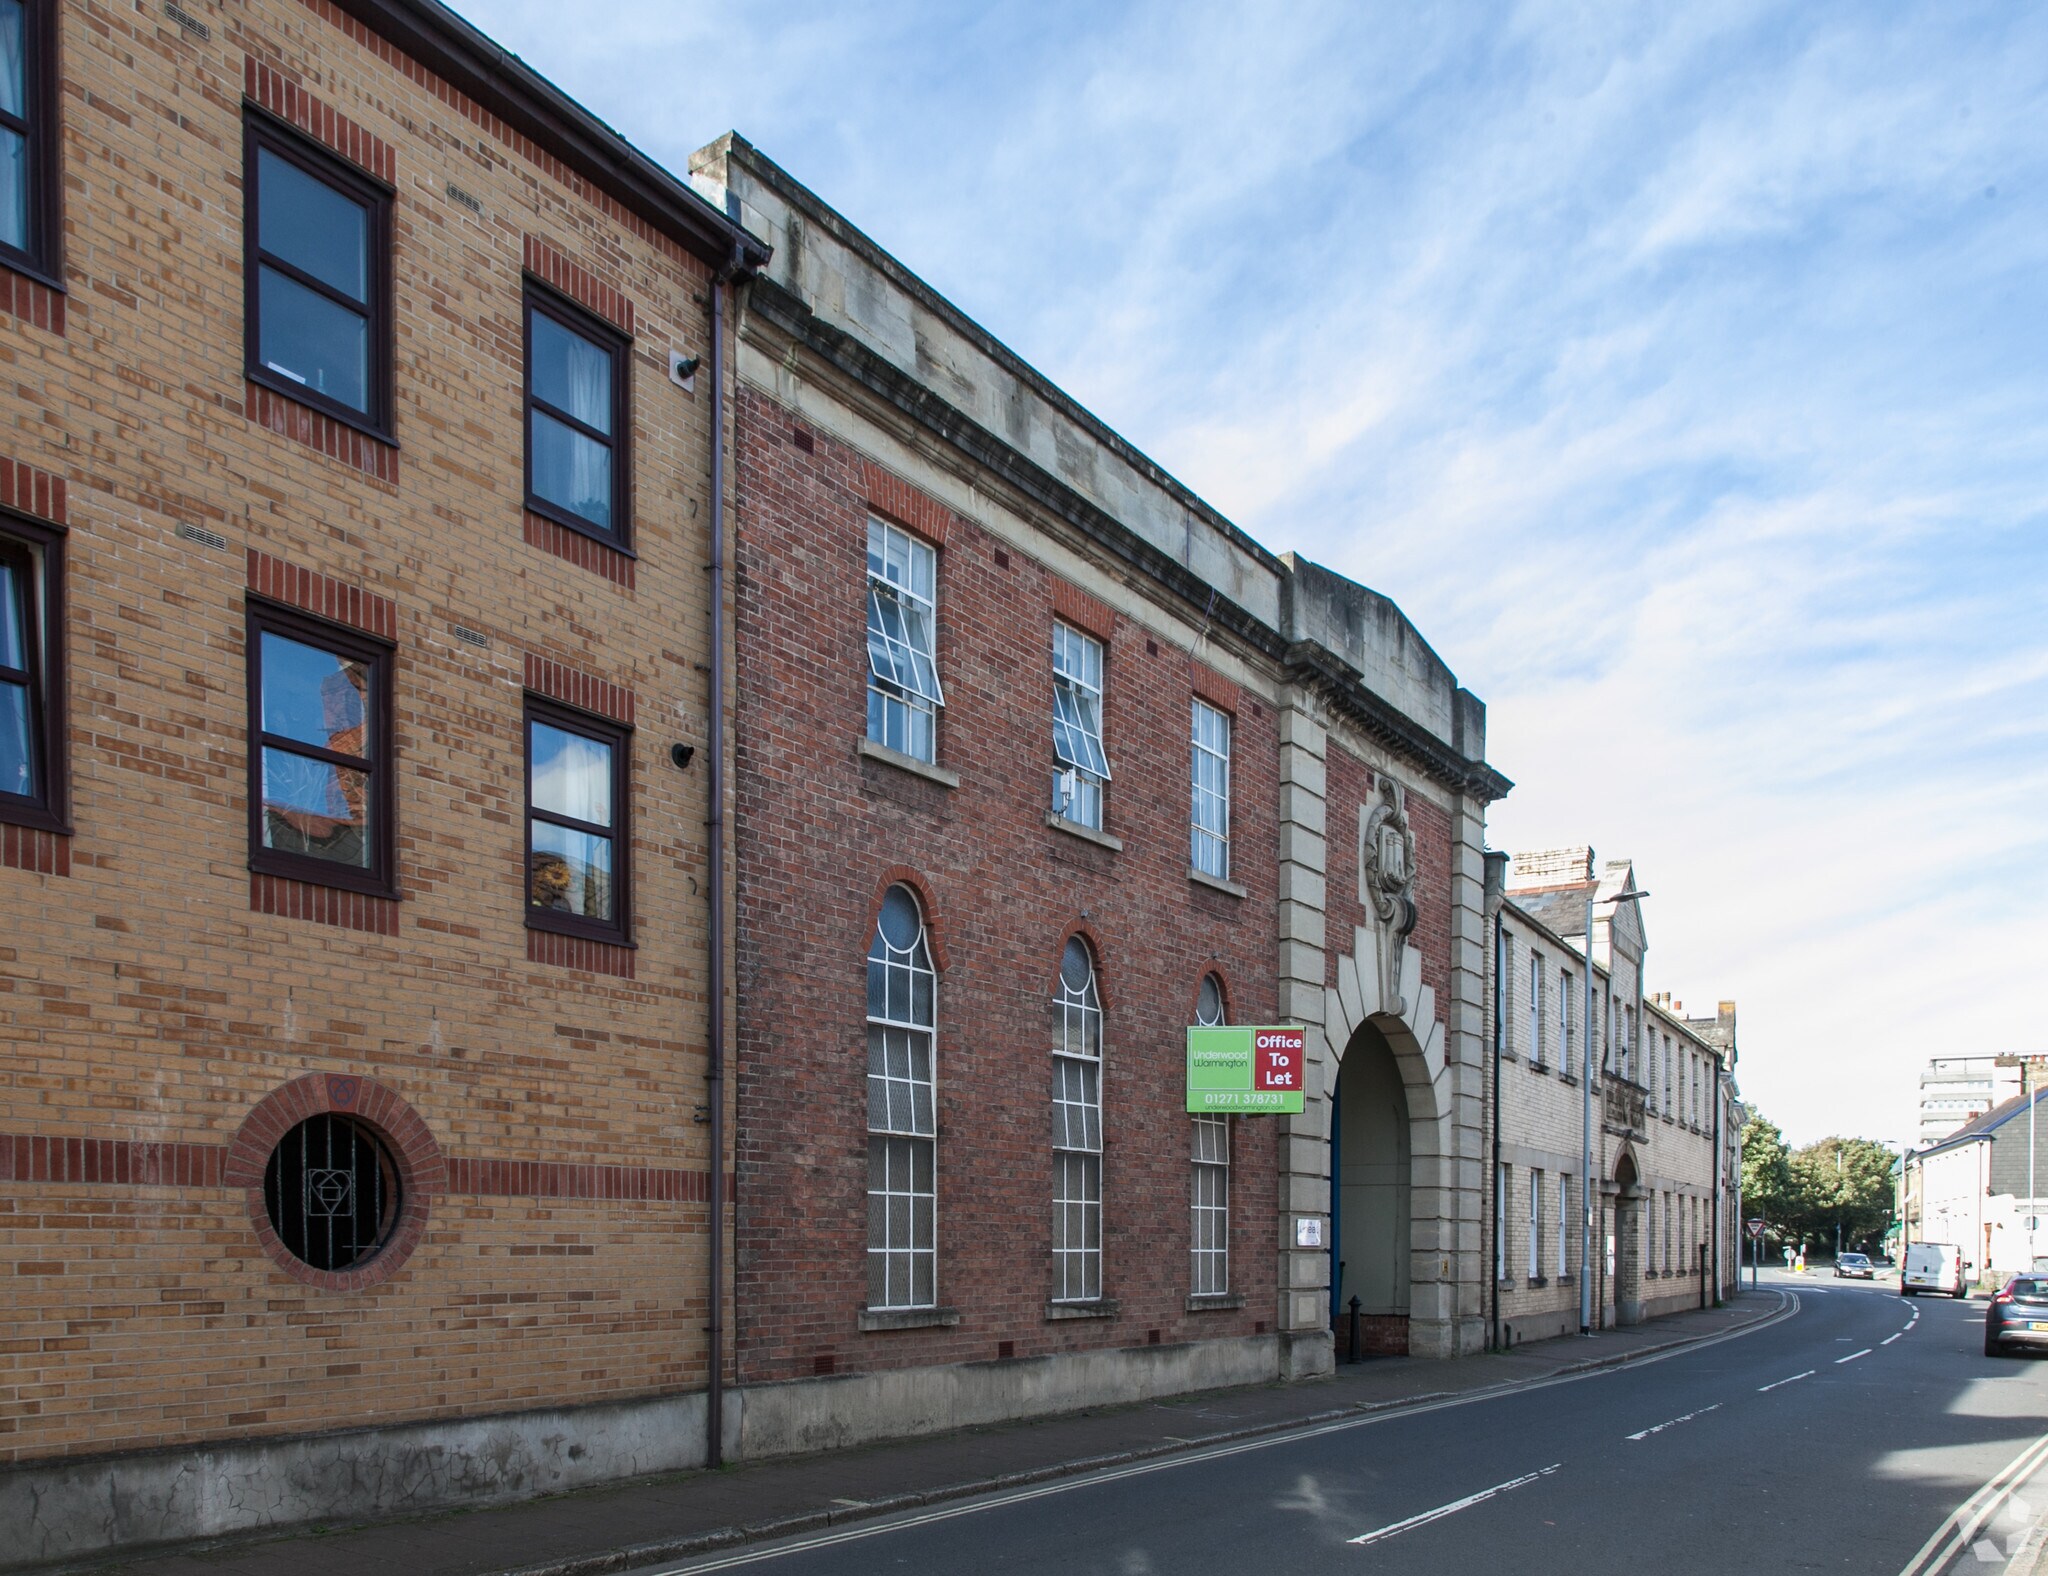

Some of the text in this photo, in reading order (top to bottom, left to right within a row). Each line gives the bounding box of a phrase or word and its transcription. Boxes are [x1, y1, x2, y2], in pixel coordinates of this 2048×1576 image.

[1256, 1035, 1302, 1048] Office
[1193, 1050, 1248, 1060] Underwood
[1268, 1052, 1289, 1067] To
[1193, 1059, 1248, 1069] Warmington
[1266, 1071, 1293, 1085] Let
[1205, 1094, 1284, 1104] 01271 378731
